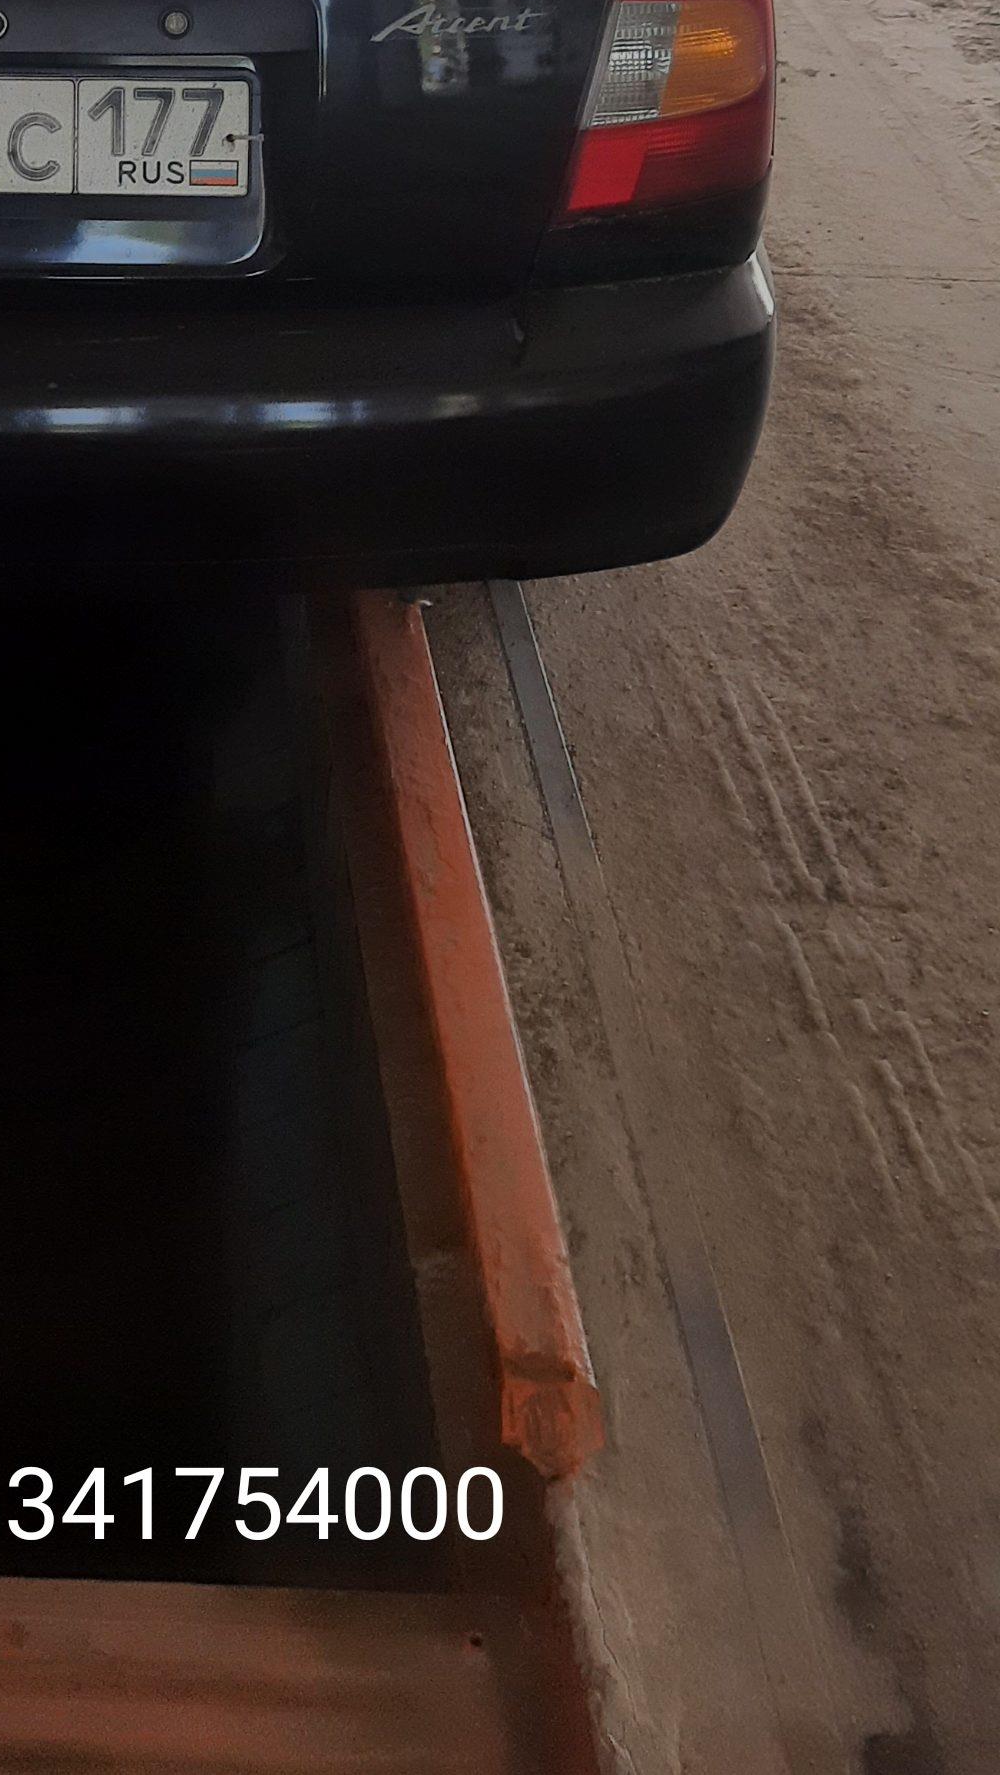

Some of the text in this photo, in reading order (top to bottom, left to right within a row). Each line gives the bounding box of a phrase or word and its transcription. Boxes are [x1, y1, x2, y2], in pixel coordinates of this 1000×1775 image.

[369, 2, 549, 42] Accent
[88, 87, 224, 157] 177
[118, 160, 185, 185] RUS
